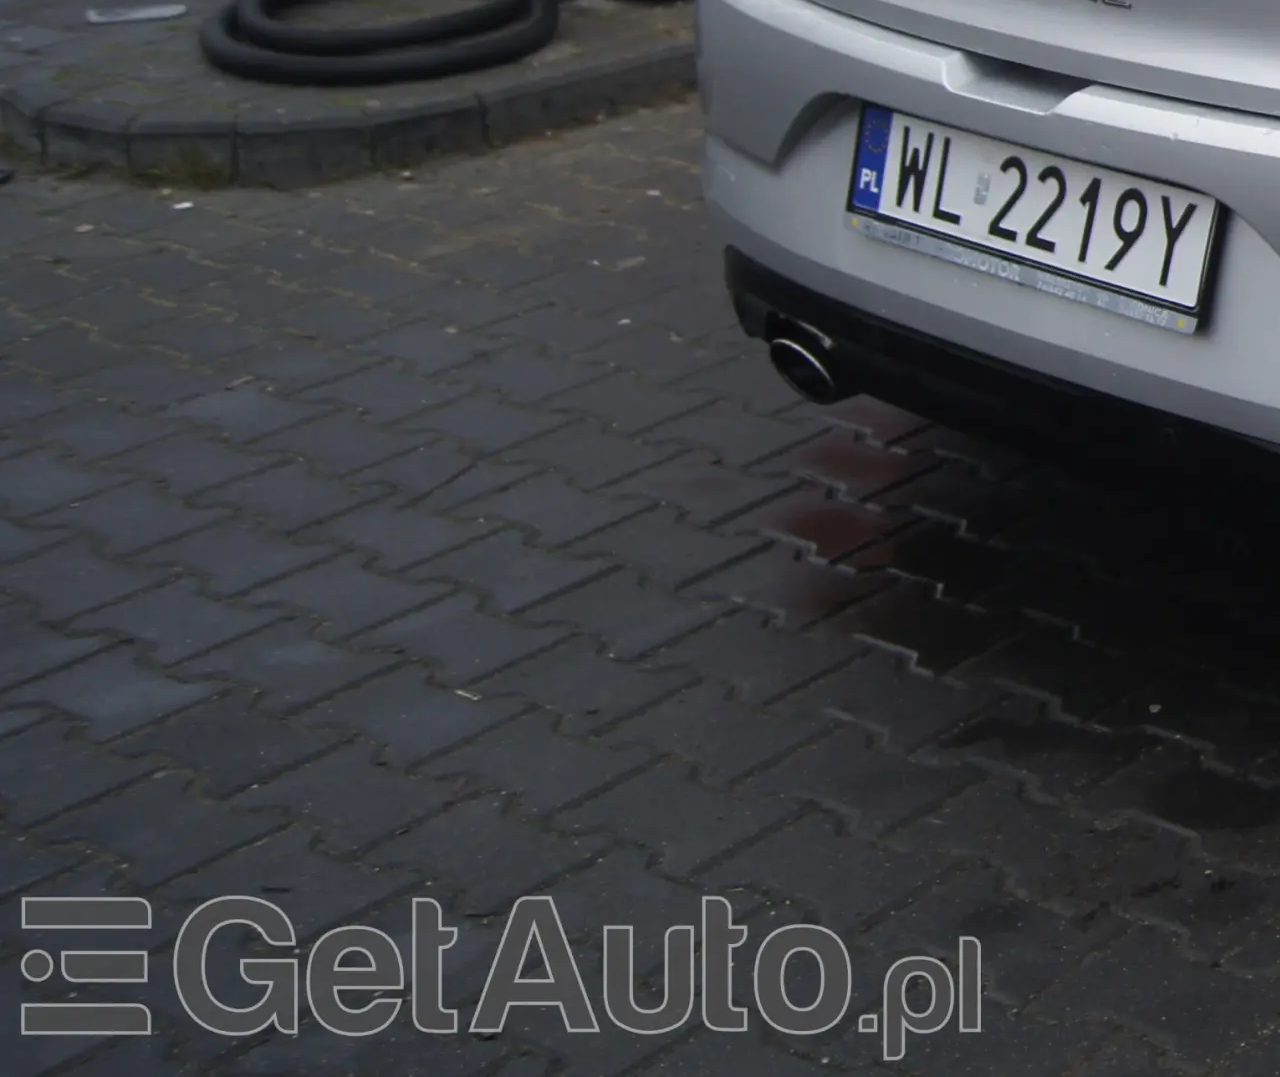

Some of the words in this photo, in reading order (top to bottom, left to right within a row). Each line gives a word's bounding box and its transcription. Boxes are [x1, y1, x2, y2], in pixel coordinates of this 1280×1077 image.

[859, 166, 880, 194] PL
[896, 125, 962, 226] WL
[988, 155, 1199, 288] 2219Y
